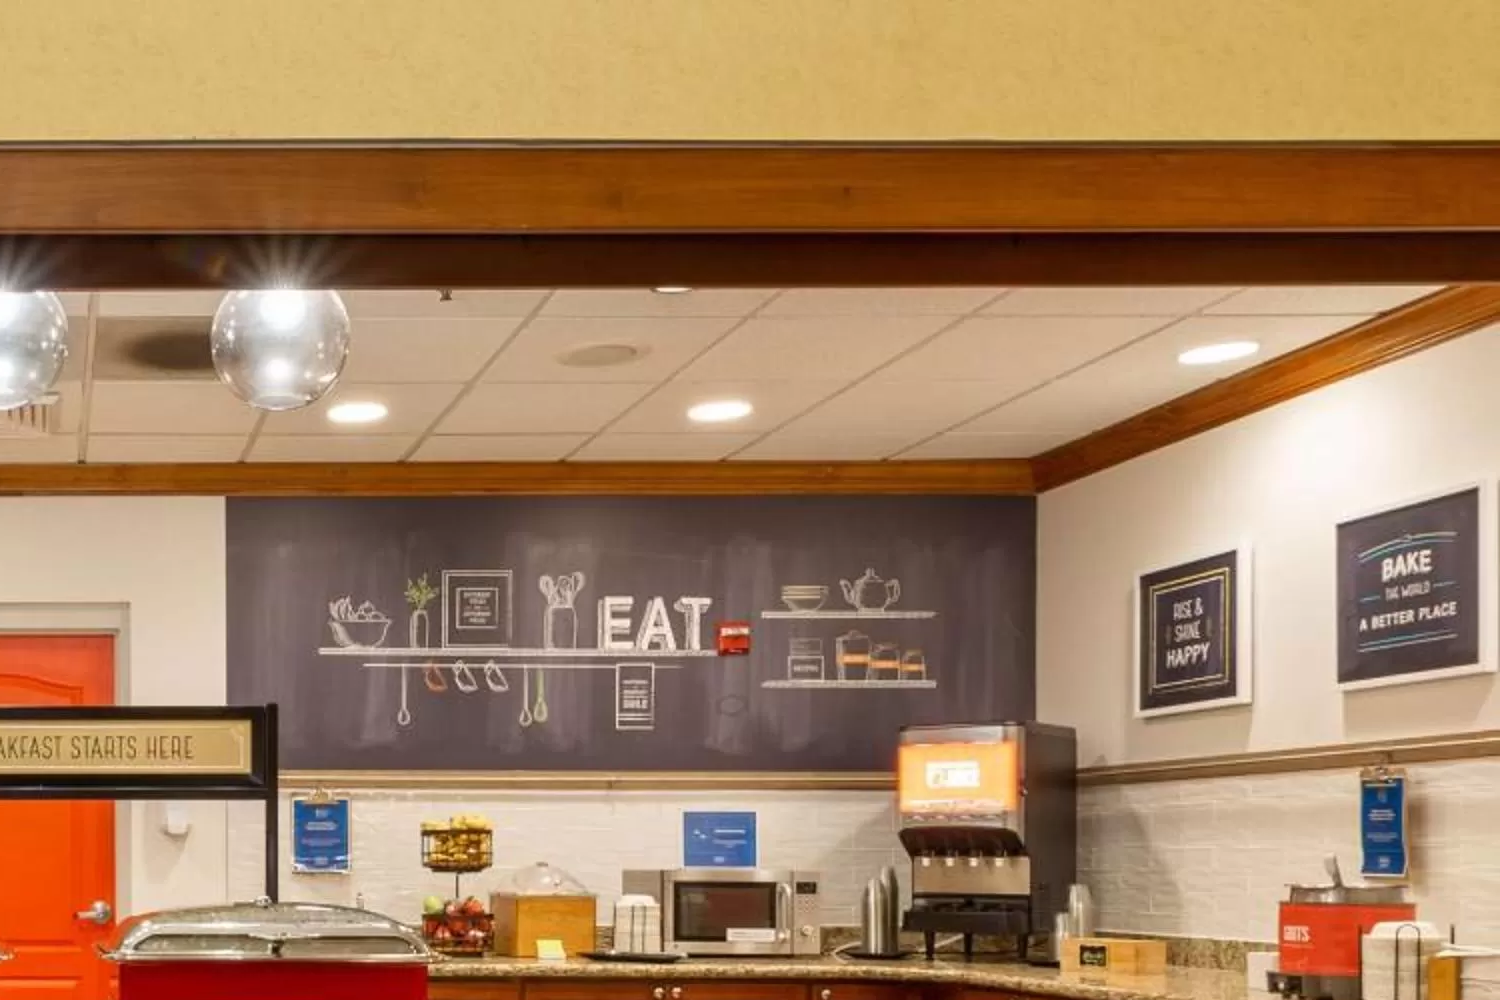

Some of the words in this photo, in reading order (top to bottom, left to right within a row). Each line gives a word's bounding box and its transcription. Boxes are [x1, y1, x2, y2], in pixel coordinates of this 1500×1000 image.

[1381, 549, 1432, 582] BAKE
[1401, 581, 1431, 598] WORLD
[1173, 599, 1192, 620] RISE
[1359, 618, 1368, 632] A
[1371, 609, 1415, 630] BETTER
[1418, 601, 1457, 621] PLACE
[597, 595, 713, 651] EAT
[1174, 620, 1201, 642] SHINE
[1166, 641, 1210, 669] HAPPY
[70, 735, 138, 760] STARTS
[146, 735, 194, 759] HERE
